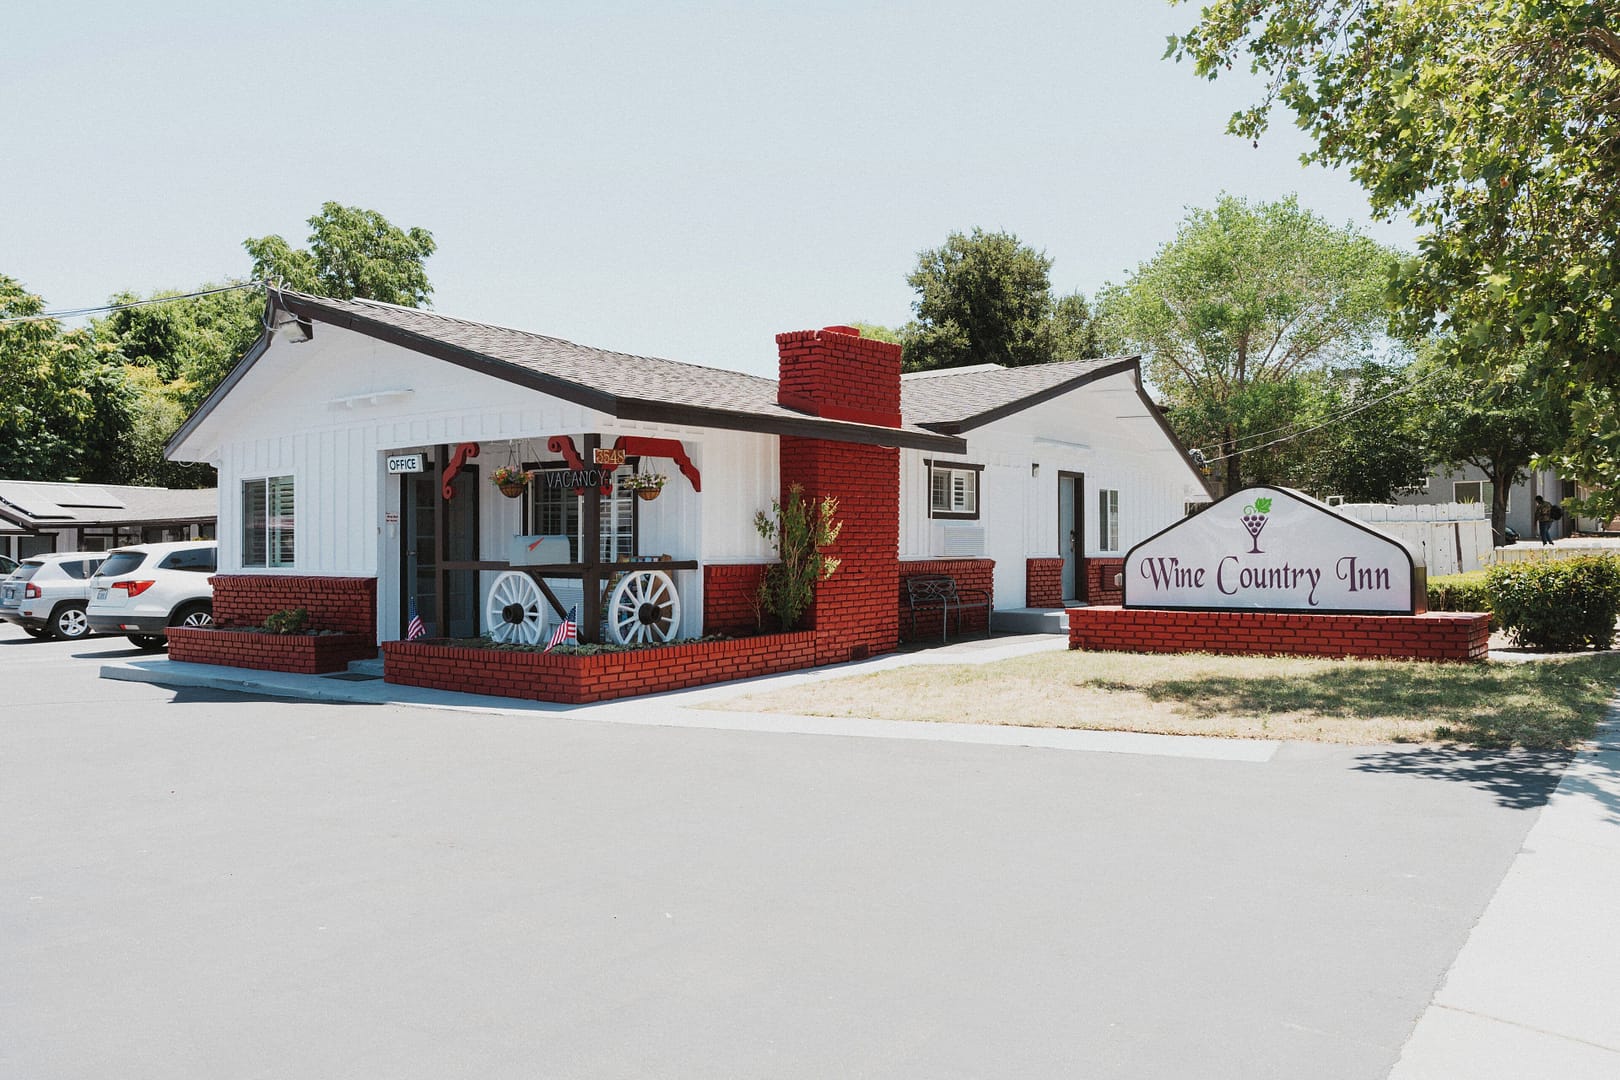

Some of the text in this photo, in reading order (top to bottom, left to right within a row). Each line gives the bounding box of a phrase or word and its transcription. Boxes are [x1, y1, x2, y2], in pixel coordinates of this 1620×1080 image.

[389, 458, 416, 470] OFFICE
[596, 449, 624, 464] 3548
[546, 470, 606, 488] VACANCY
[1140, 555, 1390, 606] Wine Country Inn
